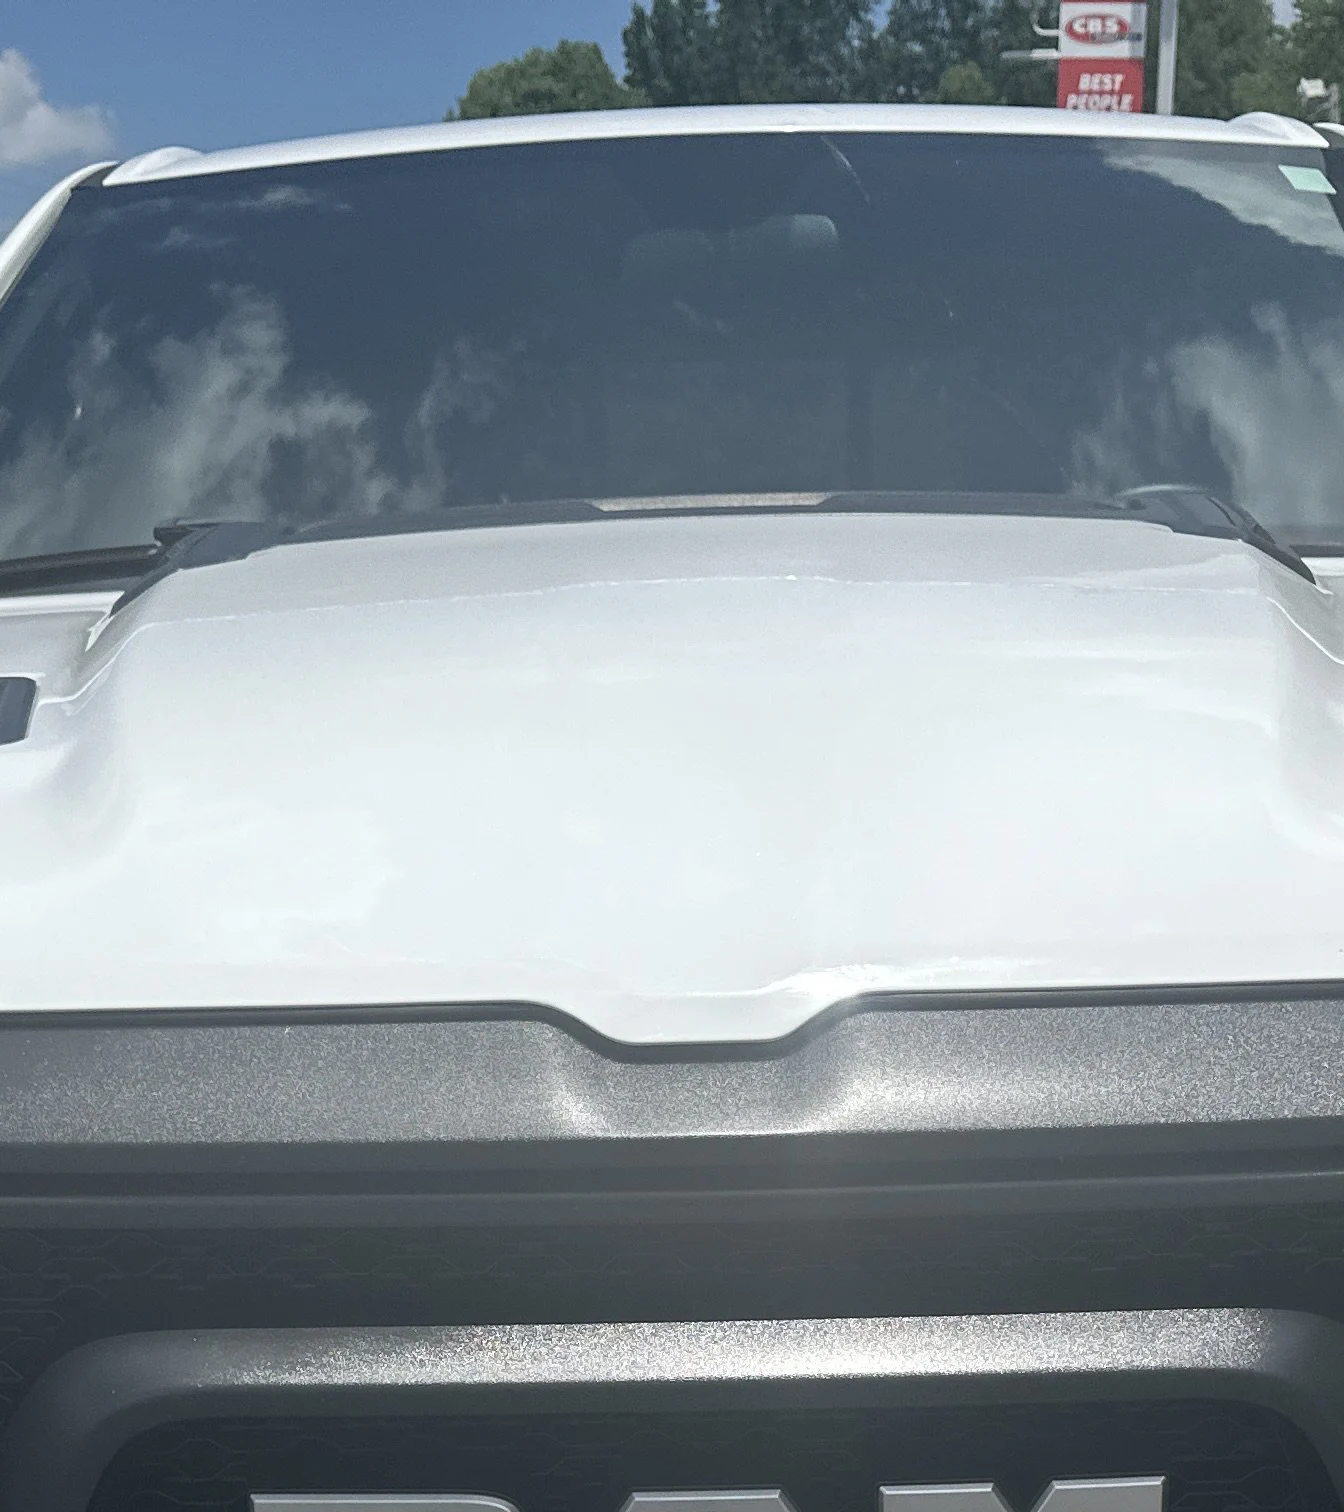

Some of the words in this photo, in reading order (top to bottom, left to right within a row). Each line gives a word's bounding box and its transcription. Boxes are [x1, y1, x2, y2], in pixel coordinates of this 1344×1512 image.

[1071, 18, 1121, 34] CBS
[1077, 73, 1126, 91] BEST
[1065, 93, 1134, 112] PEOPLE
